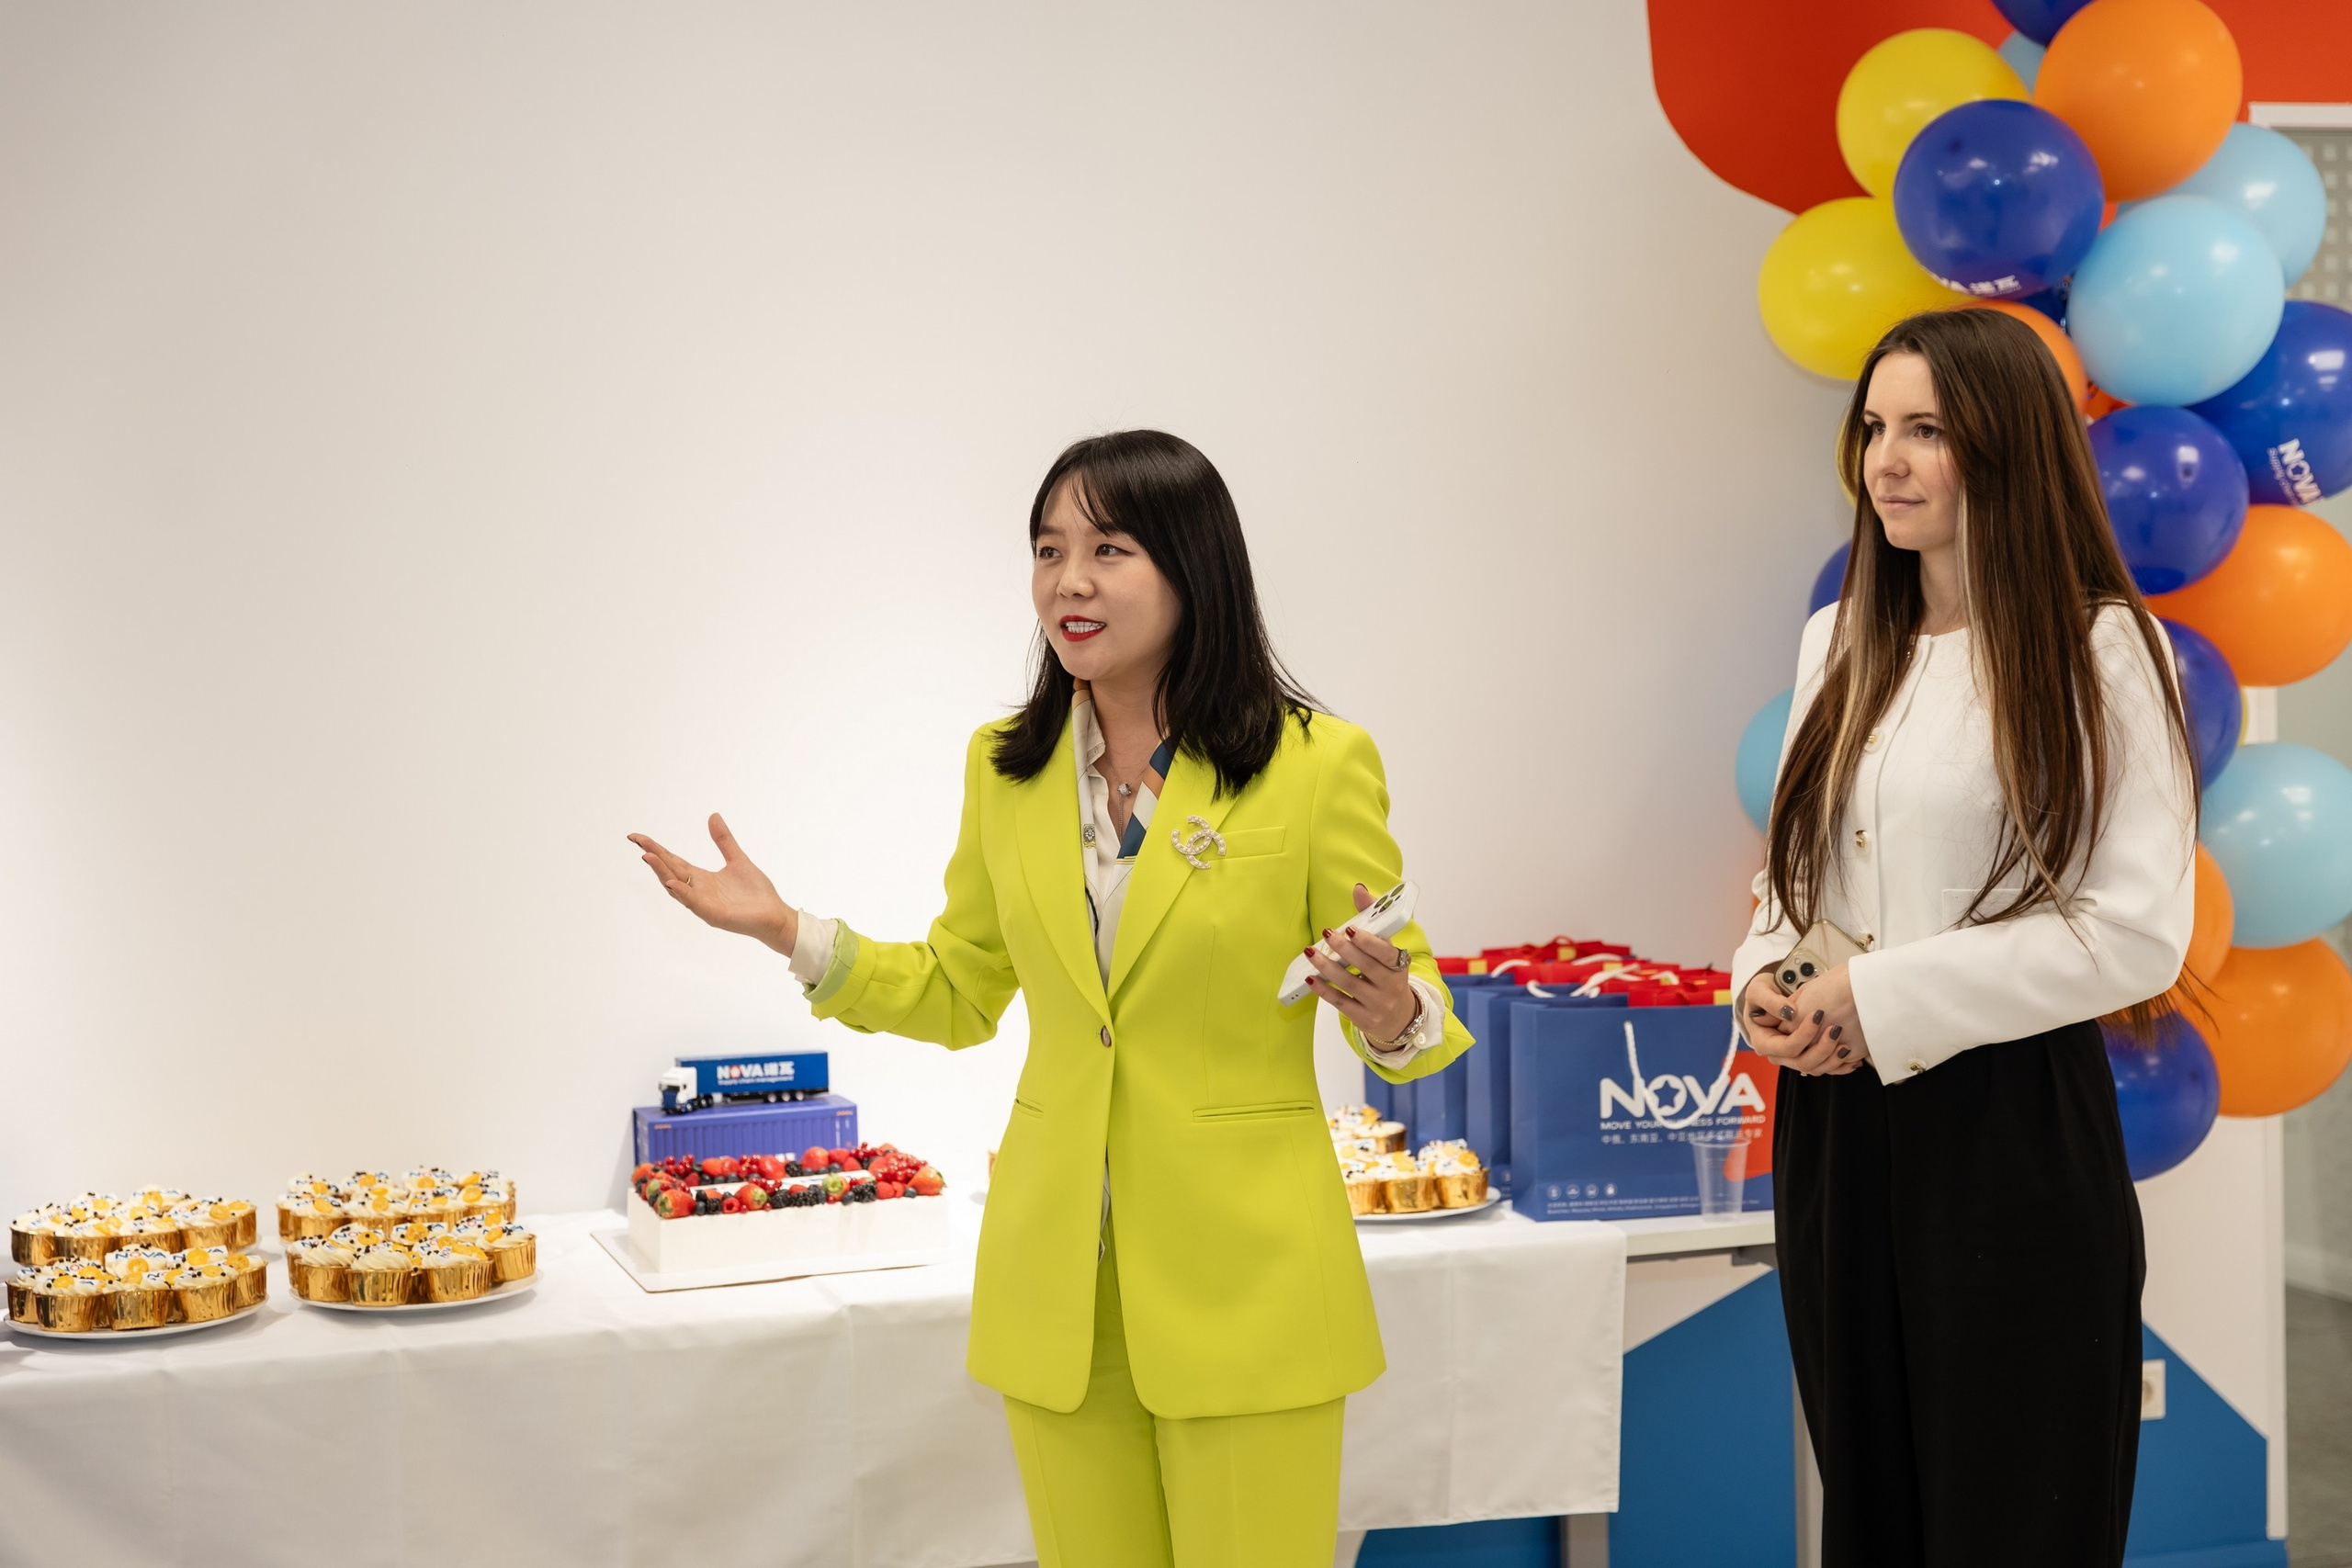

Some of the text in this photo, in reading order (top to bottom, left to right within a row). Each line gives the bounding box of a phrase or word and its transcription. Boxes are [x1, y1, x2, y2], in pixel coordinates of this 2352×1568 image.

[1600, 1073, 1766, 1119] NOVA
[1600, 1121, 1632, 1130] MOVE
[1715, 1115, 1766, 1126] FORWARD
[115, 1250, 166, 1260] NOVA
